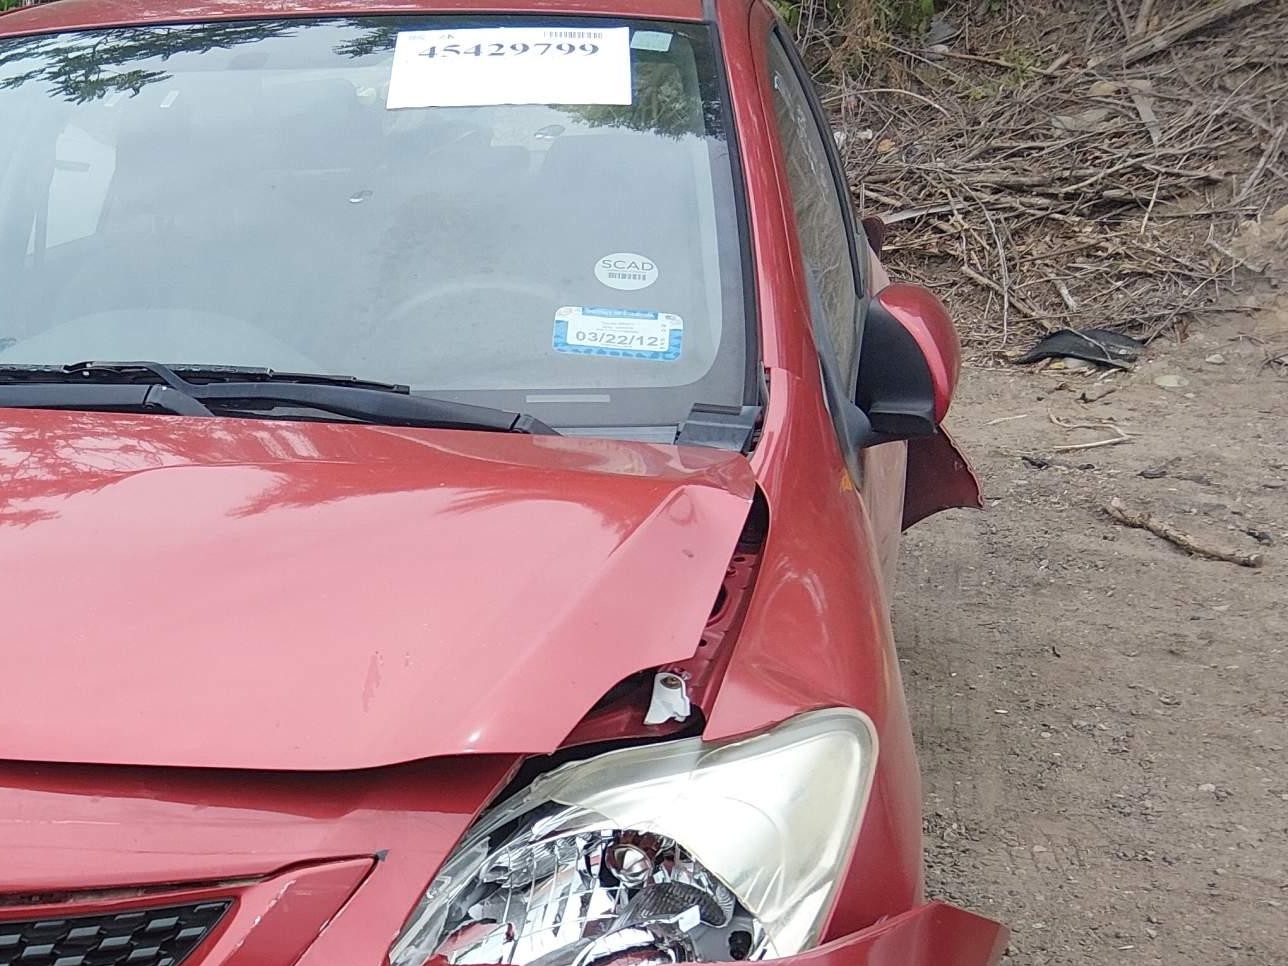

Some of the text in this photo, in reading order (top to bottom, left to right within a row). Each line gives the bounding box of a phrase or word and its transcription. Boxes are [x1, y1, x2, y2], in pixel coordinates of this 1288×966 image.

[417, 42, 600, 59] 45429799
[601, 259, 654, 271] SCAD
[575, 331, 659, 347] 03/22/12
